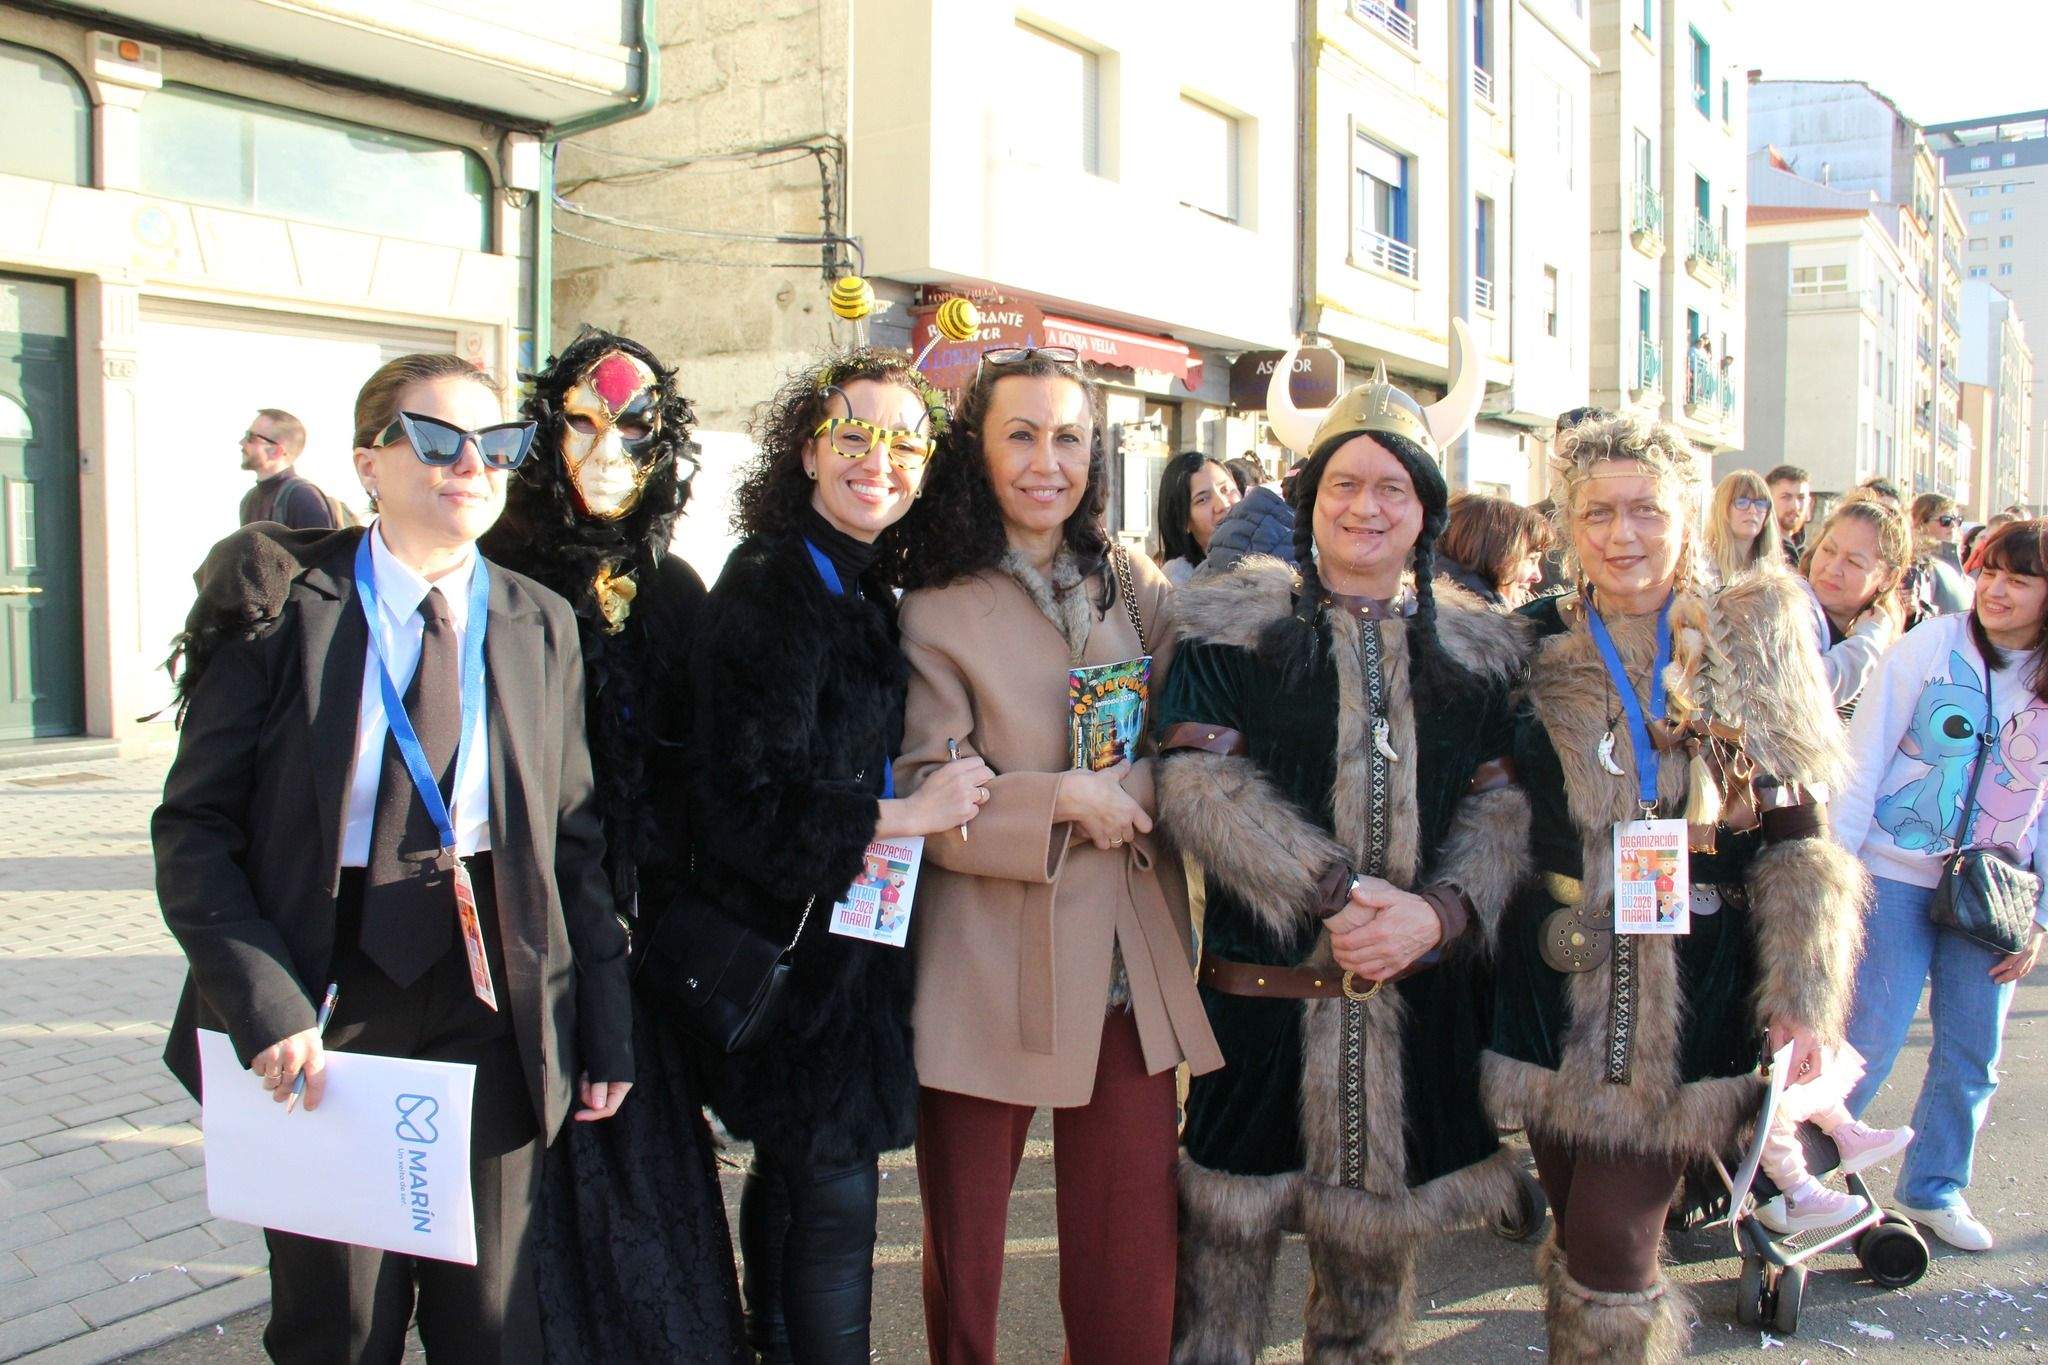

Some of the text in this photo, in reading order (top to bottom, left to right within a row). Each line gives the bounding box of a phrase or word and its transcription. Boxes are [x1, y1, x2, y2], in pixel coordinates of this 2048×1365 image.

[1256, 358, 1312, 375] ASOR
[1620, 833, 1679, 848] ORGANIZACIÓN
[855, 899, 875, 915] 2026
[1634, 896, 1652, 909] 2026
[408, 1149, 436, 1233] MARÍN
